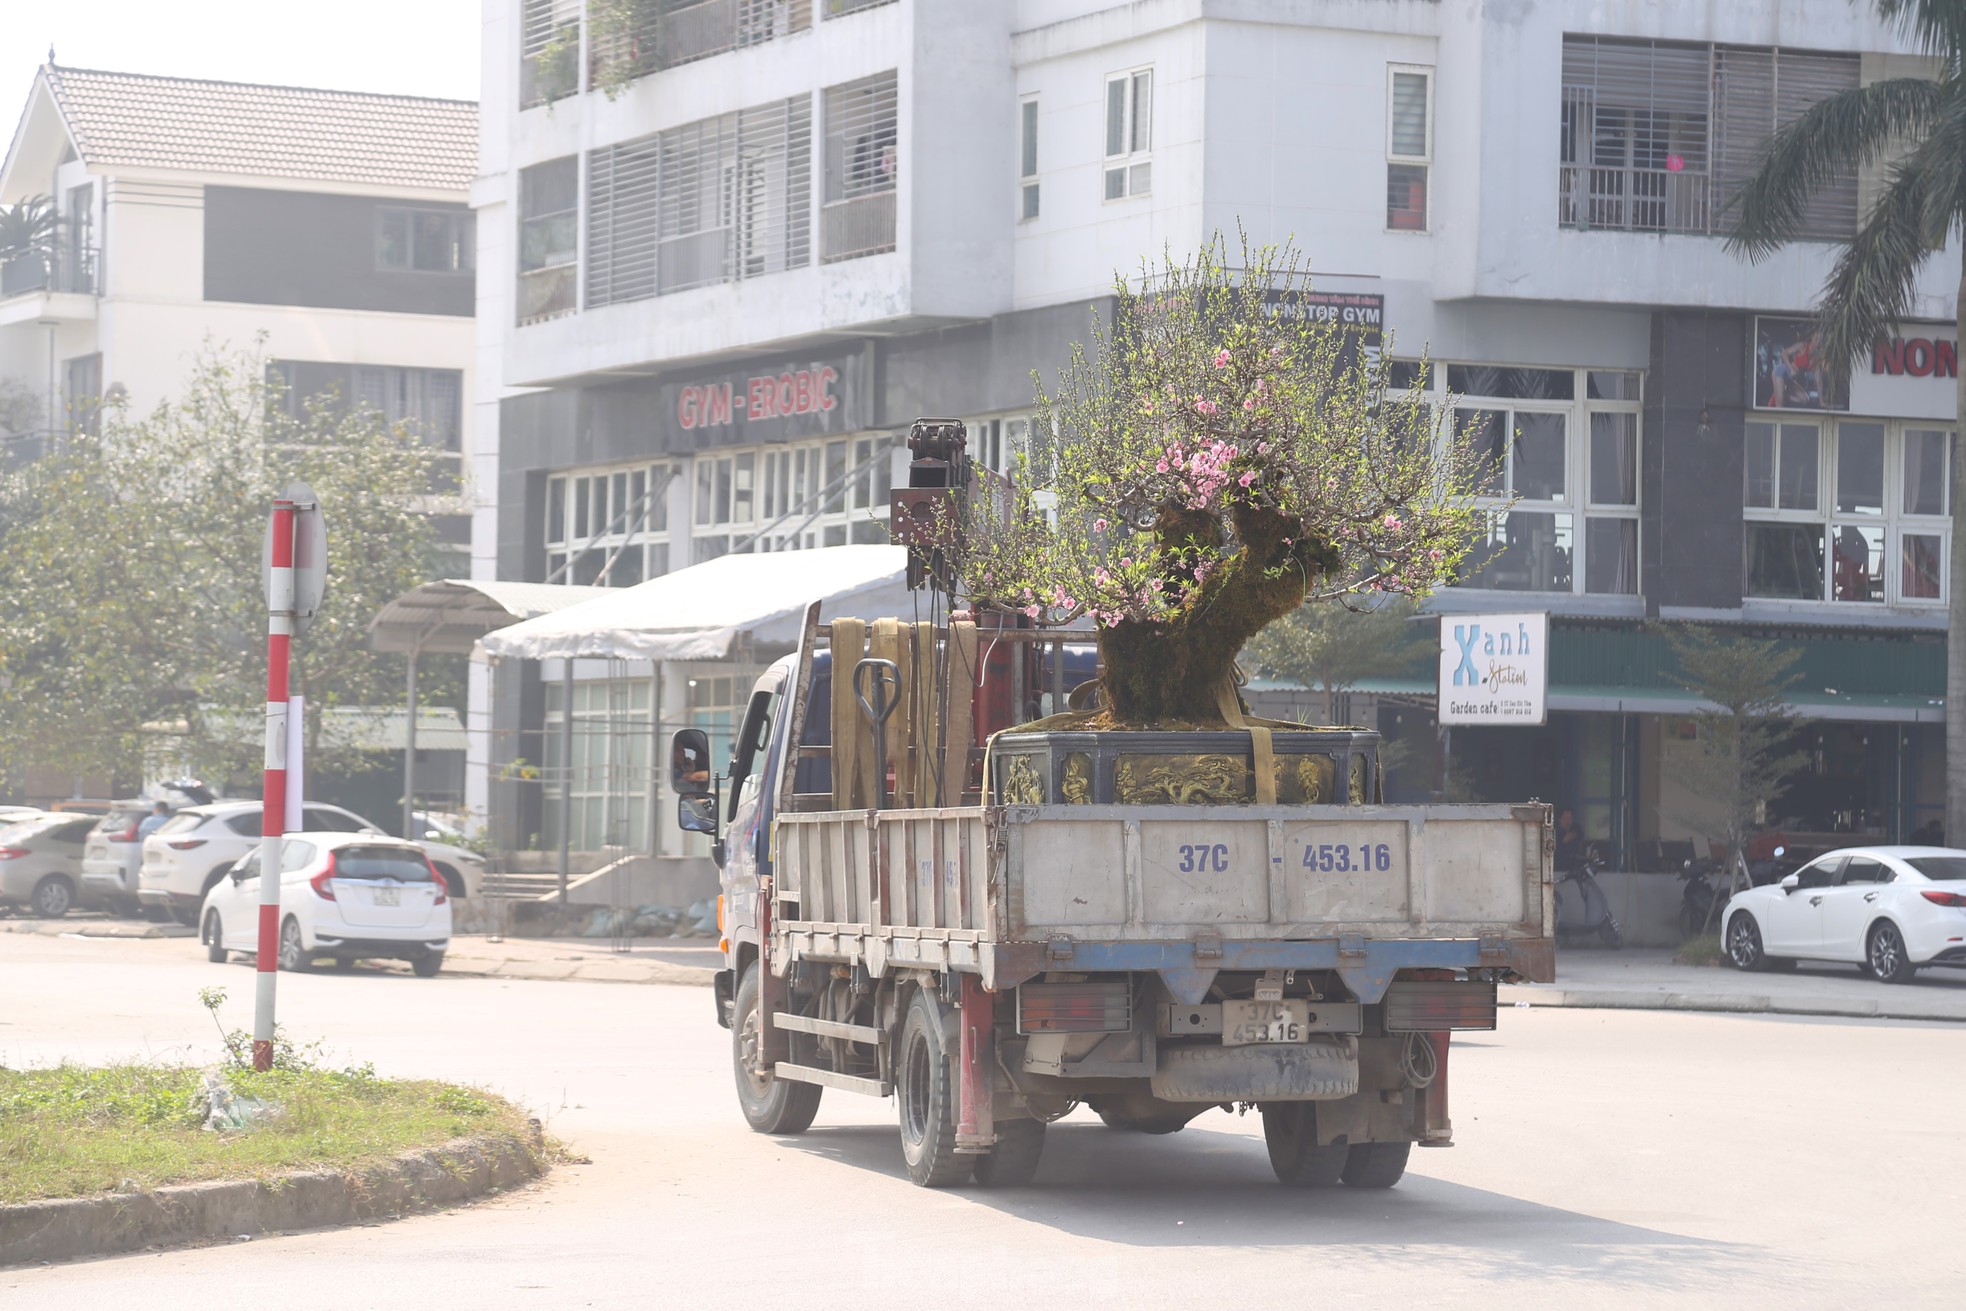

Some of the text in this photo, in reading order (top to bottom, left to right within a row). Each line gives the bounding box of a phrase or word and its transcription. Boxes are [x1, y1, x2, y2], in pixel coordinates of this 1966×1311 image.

[1343, 307, 1379, 324] GYM
[1873, 338, 1958, 378] NON
[1453, 622, 1530, 687] Xanh
[1451, 701, 1477, 714] Garden
[1481, 701, 1498, 714] cafe
[1179, 844, 1228, 872] 37C
[1303, 844, 1390, 872] 453.16
[1247, 1002, 1284, 1021] 37C
[1233, 1023, 1299, 1042] 453.16
